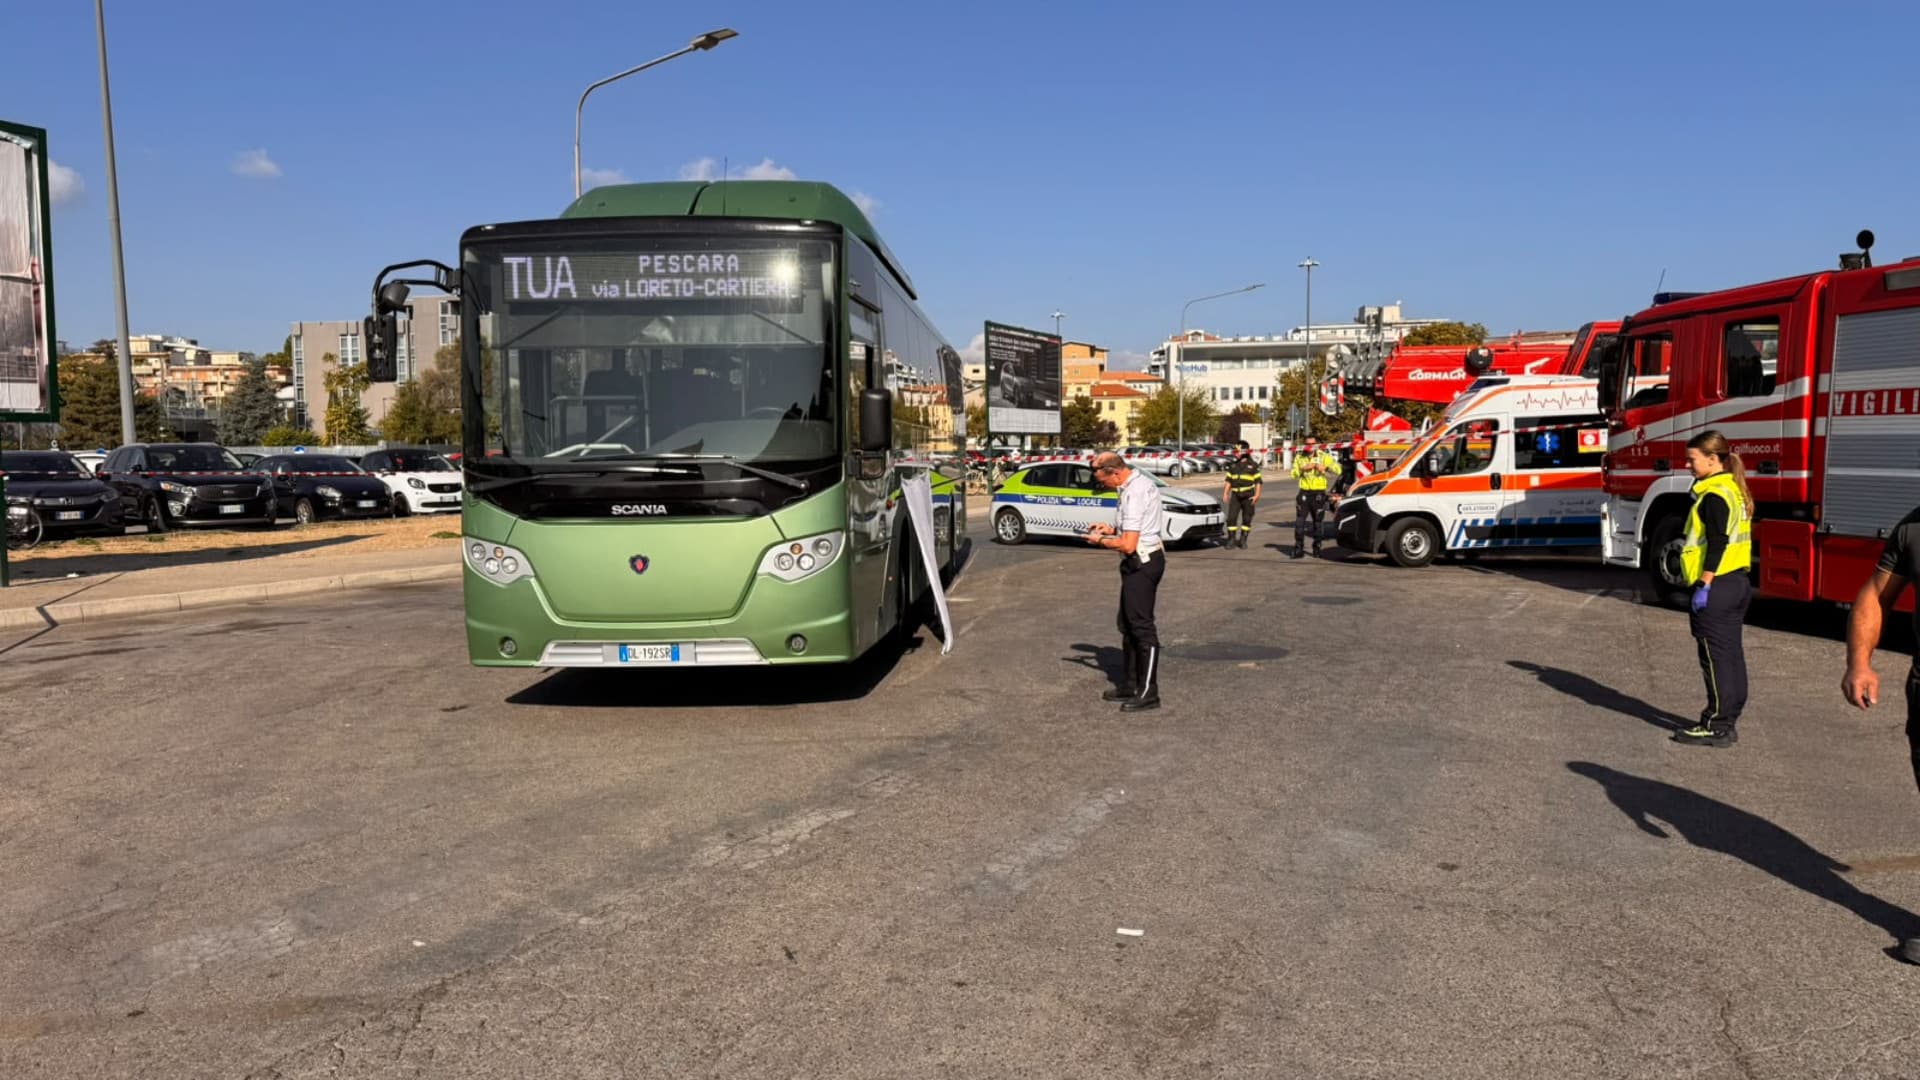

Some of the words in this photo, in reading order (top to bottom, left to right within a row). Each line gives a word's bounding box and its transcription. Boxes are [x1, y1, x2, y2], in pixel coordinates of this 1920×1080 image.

[638, 255, 739, 274] PESCARA
[503, 256, 577, 299] TUA
[591, 279, 620, 298] via
[1408, 368, 1466, 381] CORMACH
[1834, 388, 1920, 416] VIGILI
[1631, 446, 1650, 457] 115
[1037, 495, 1059, 505] POLIZIA
[1077, 498, 1103, 507] LOCALE
[611, 504, 668, 515] SCANIA
